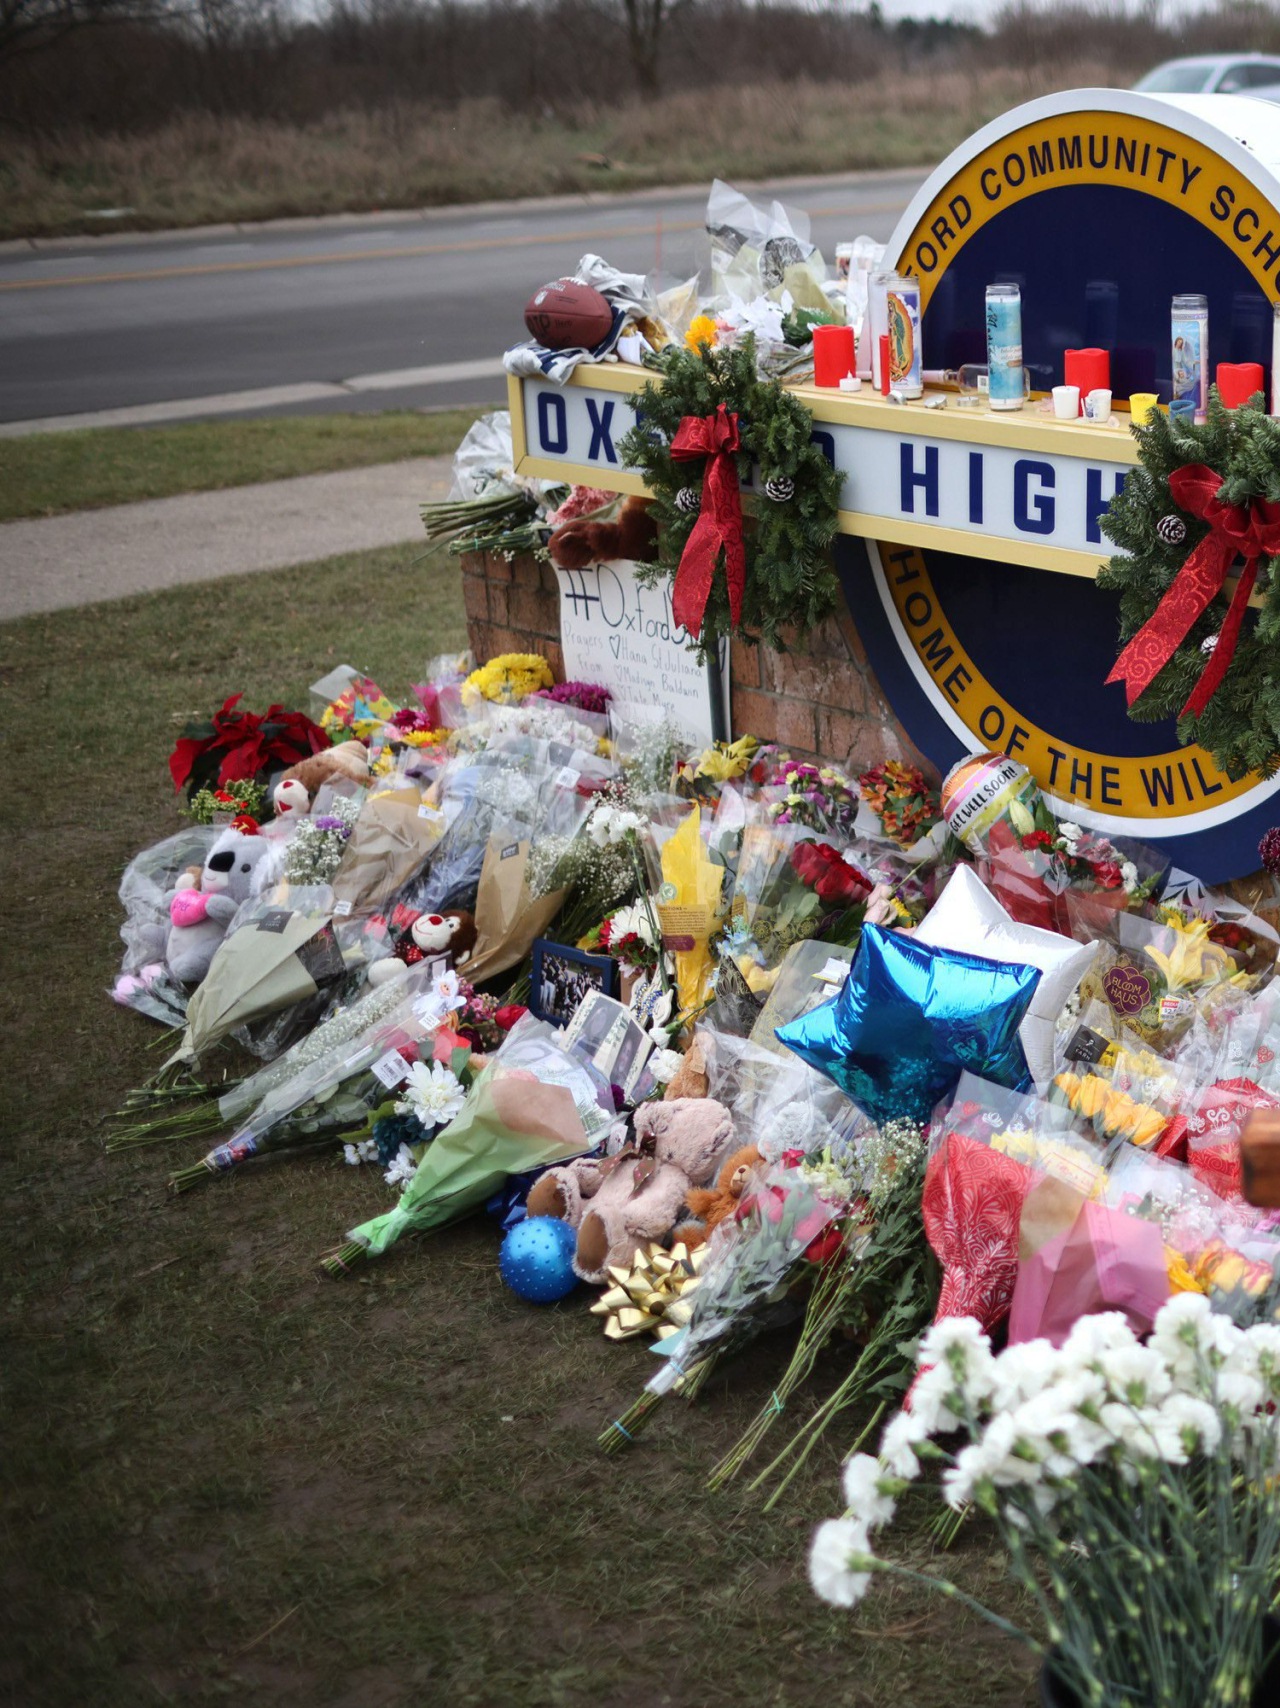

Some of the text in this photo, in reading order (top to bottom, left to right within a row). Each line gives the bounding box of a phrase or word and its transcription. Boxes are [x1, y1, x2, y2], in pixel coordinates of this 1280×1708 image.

[980, 134, 1202, 201] COMMUNITY
[900, 442, 1127, 548] HIGH
[889, 550, 973, 703] HOME
[979, 704, 1030, 756] OF
[1046, 746, 1123, 806] THE
[949, 812, 966, 833] GET
[961, 793, 987, 818] WELL
[1110, 987, 1138, 1006] HAUS
[1112, 976, 1142, 993] BLOOM
